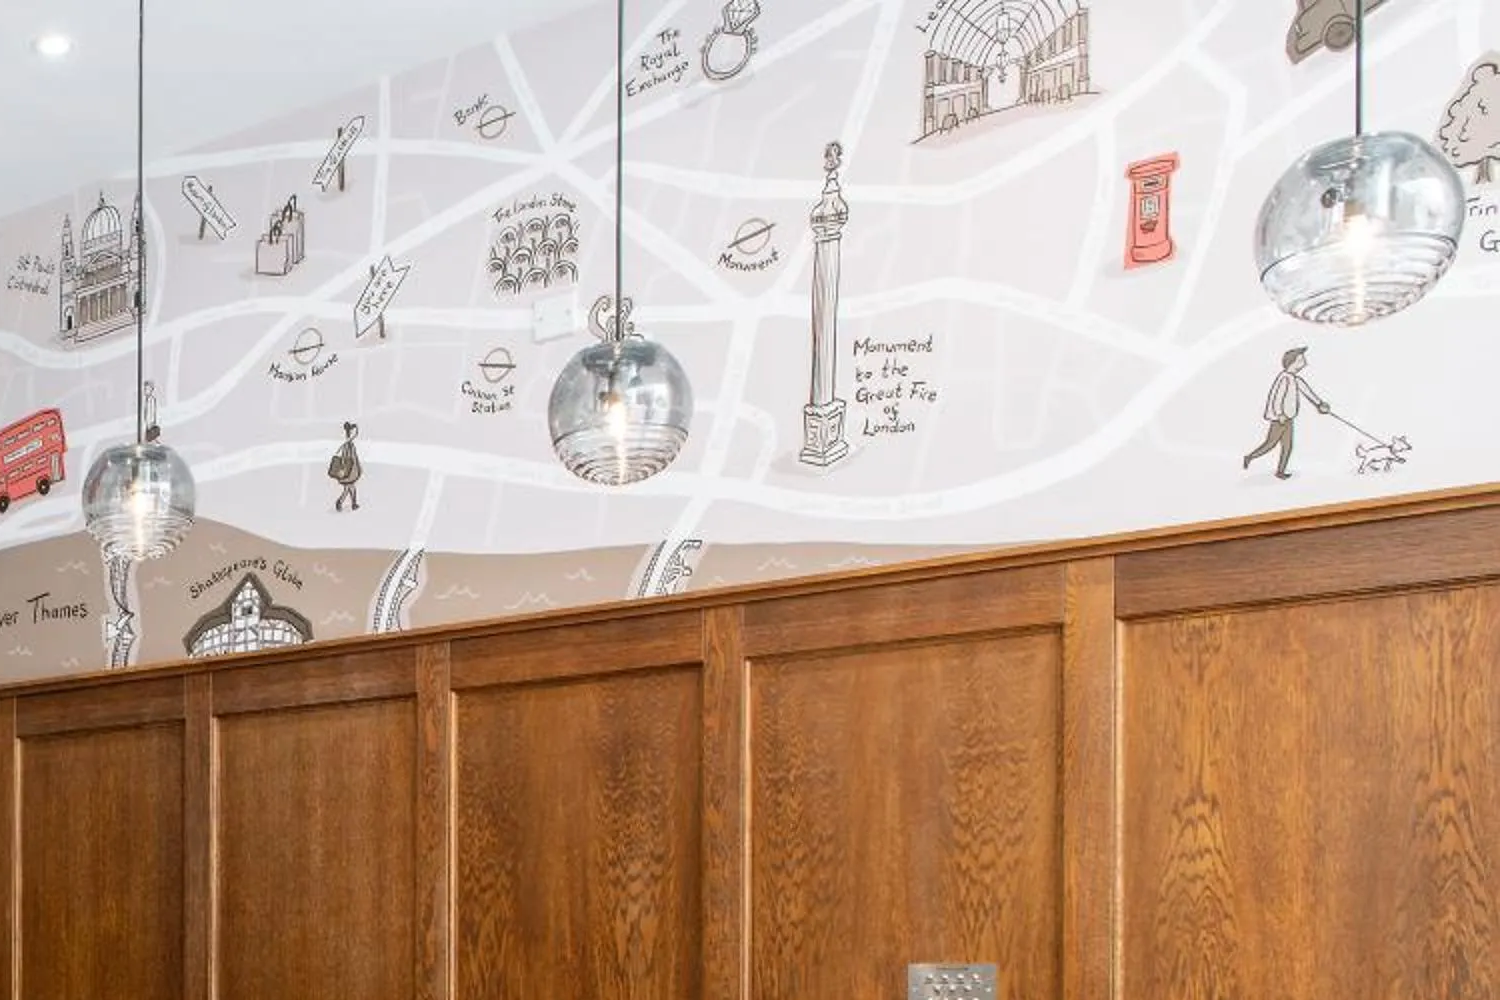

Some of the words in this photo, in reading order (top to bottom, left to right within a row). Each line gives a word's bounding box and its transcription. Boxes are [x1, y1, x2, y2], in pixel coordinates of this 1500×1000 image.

[640, 41, 680, 70] Royal
[625, 60, 689, 97] Exchange
[453, 93, 488, 126] Bank
[717, 246, 779, 272] Monument
[853, 334, 933, 356] Monument
[855, 367, 873, 382] to
[881, 358, 909, 378] the
[855, 382, 902, 404] Great
[909, 380, 938, 402] Fire
[883, 401, 900, 422] of
[863, 418, 915, 437] London
[26, 592, 88, 625] Thames
